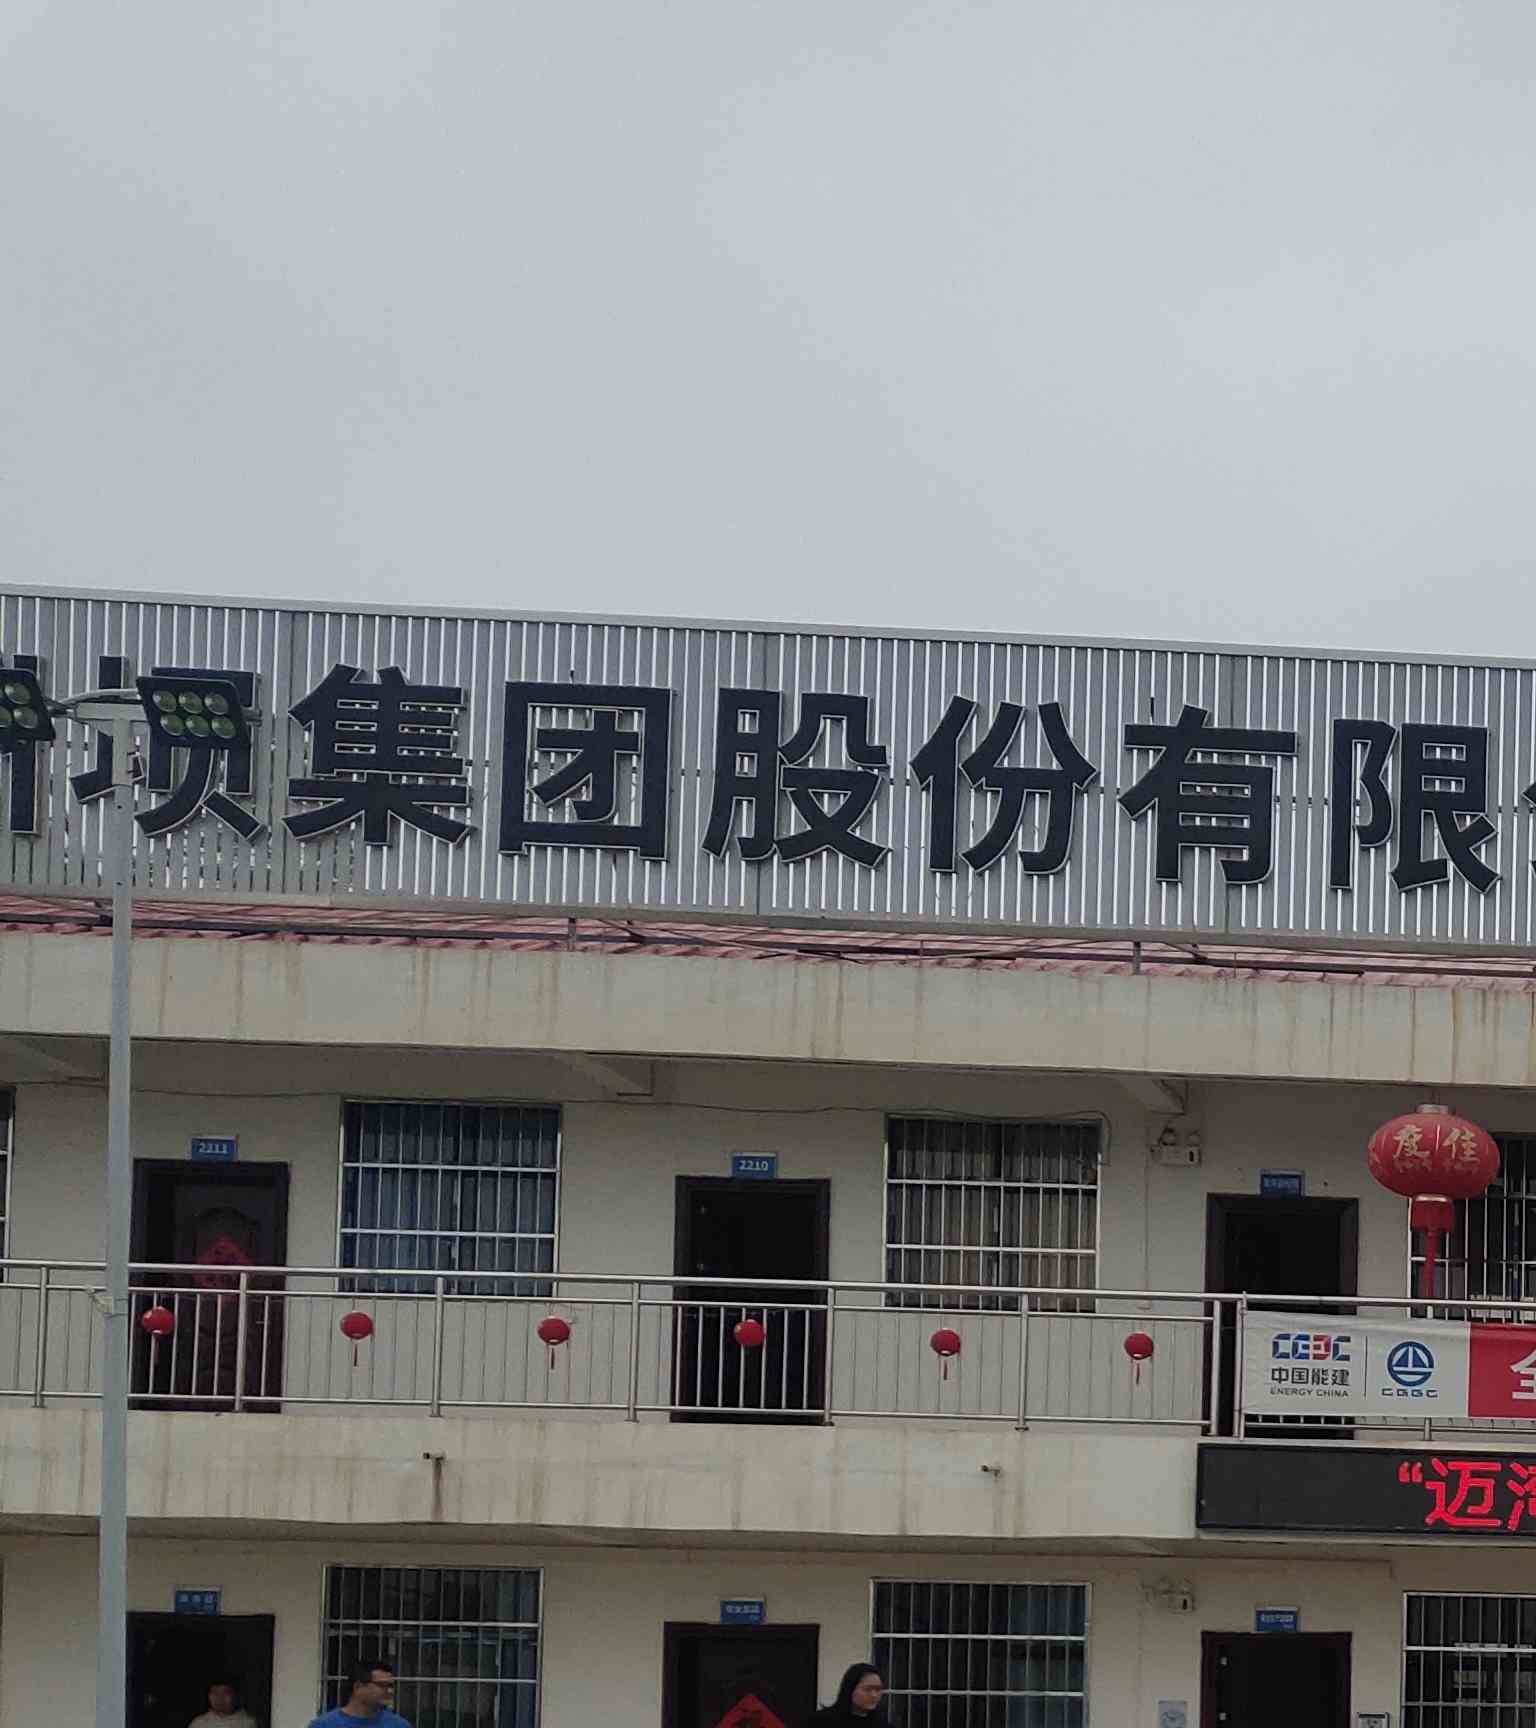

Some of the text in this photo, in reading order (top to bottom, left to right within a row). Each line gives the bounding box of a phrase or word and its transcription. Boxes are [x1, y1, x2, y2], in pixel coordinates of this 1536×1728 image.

[1270, 1366, 1350, 1387] 中国能建
[1269, 1386, 1349, 1398] ENERGY CHINA
